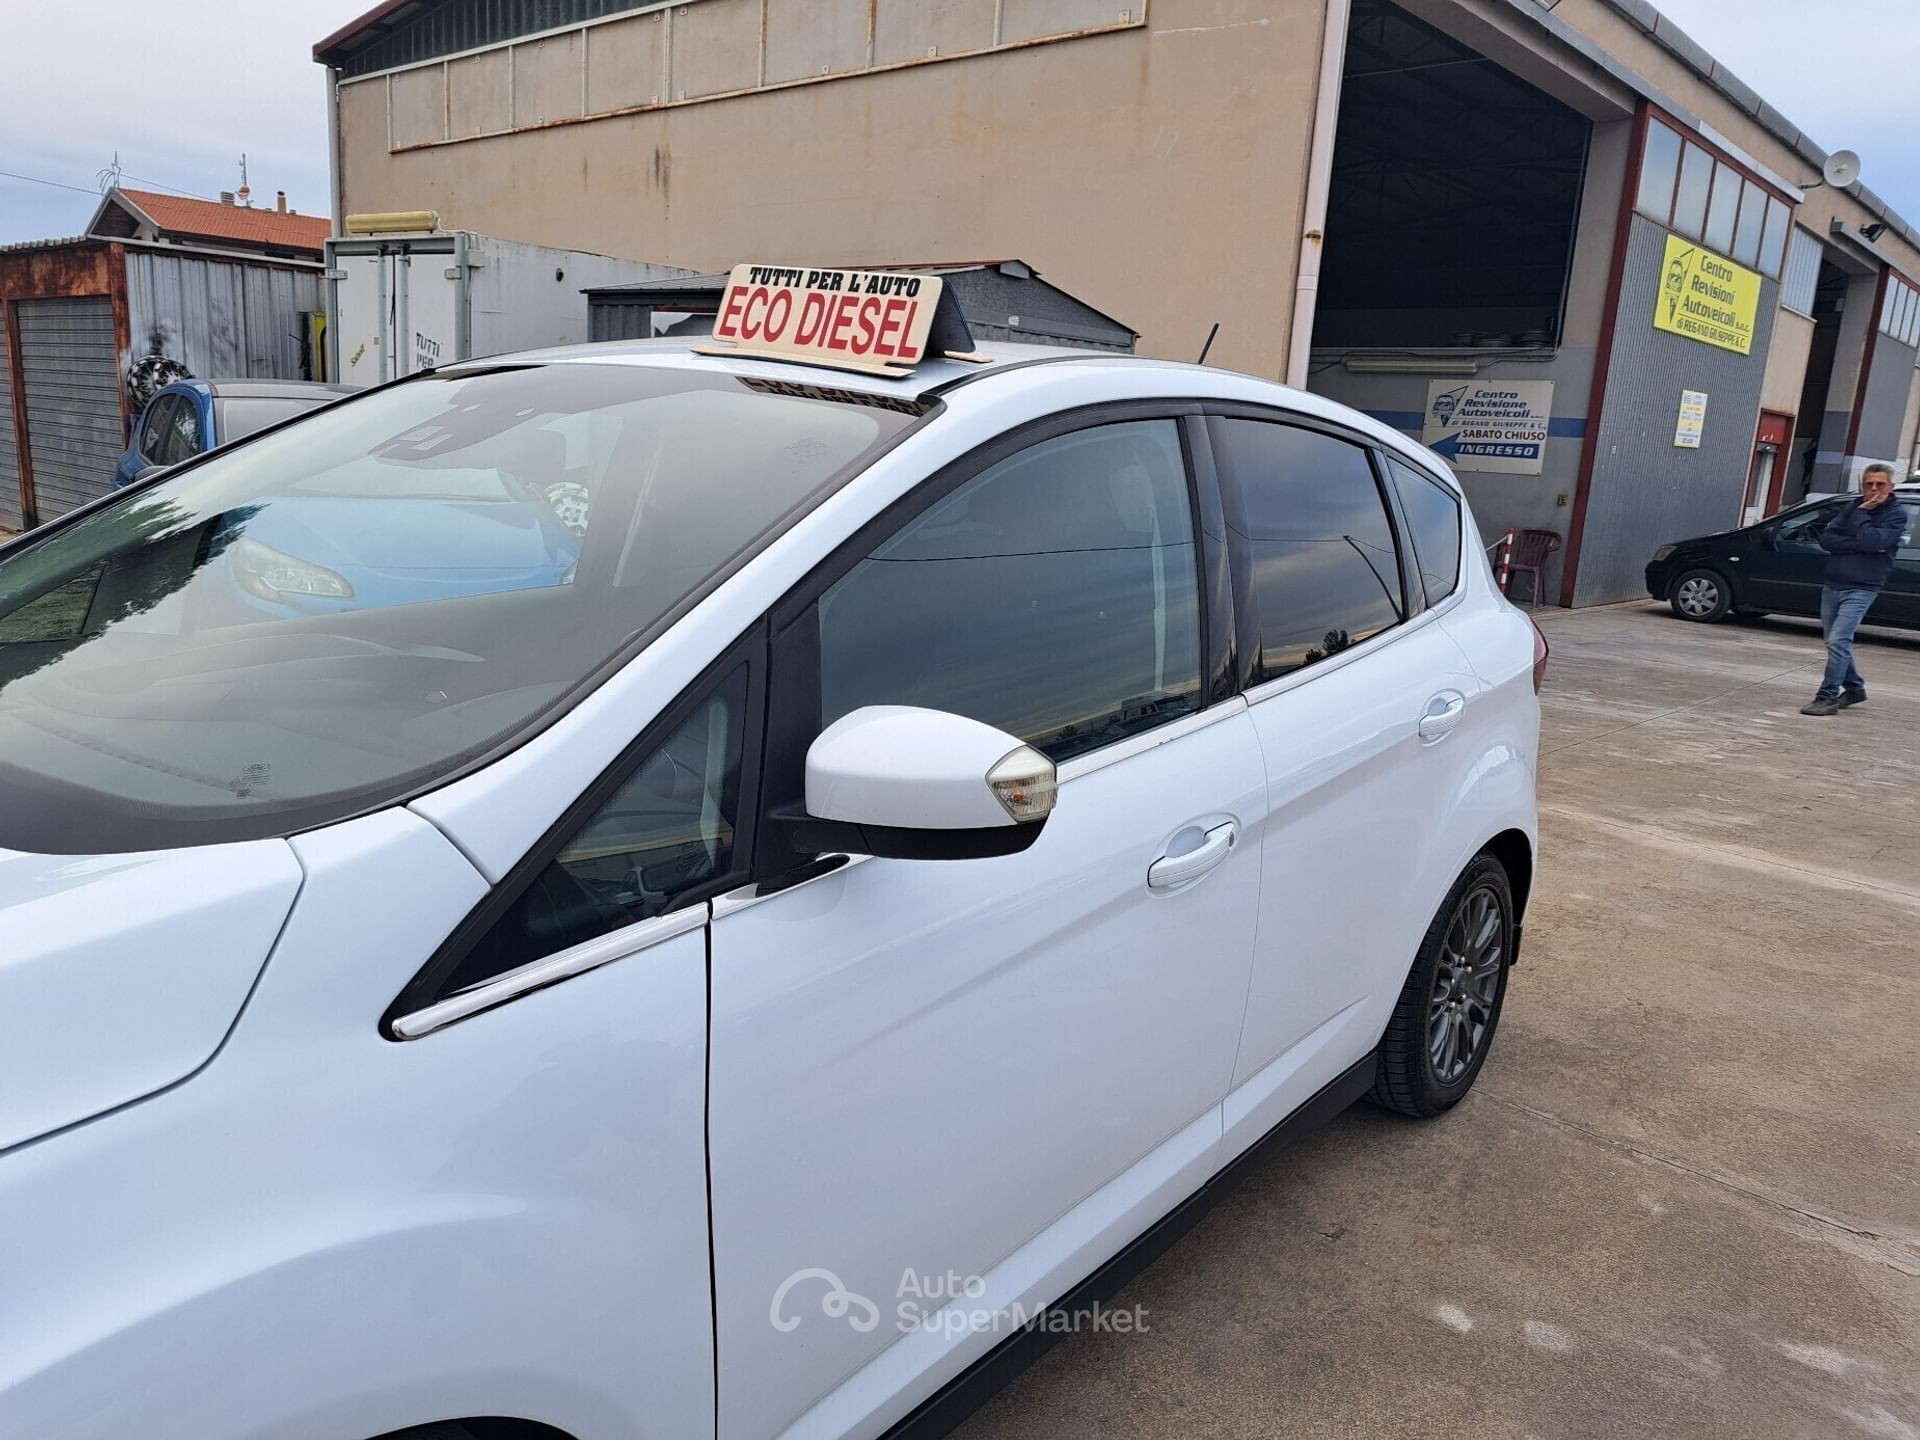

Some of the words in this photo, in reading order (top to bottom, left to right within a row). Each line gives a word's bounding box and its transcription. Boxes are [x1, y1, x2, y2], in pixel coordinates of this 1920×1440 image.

[1700, 255, 1733, 282] Centro
[750, 267, 803, 288] TUTTI
[805, 272, 844, 291] PER
[849, 273, 921, 298] L'AUTO
[1691, 274, 1736, 306] Revisioni
[1681, 295, 1737, 327] Autoveicoli
[718, 286, 793, 343] ECO
[794, 292, 919, 359] DIESEL
[1683, 319, 1710, 337] REGANO
[416, 332, 440, 358] TUTTI
[1464, 398, 1528, 409] Revisione
[1474, 390, 1518, 399] Centro
[1456, 407, 1531, 418] Autoveicoli
[1462, 429, 1503, 439] SABATO
[1504, 430, 1546, 441] CHIUSO
[1460, 444, 1534, 456] INGRESSO
